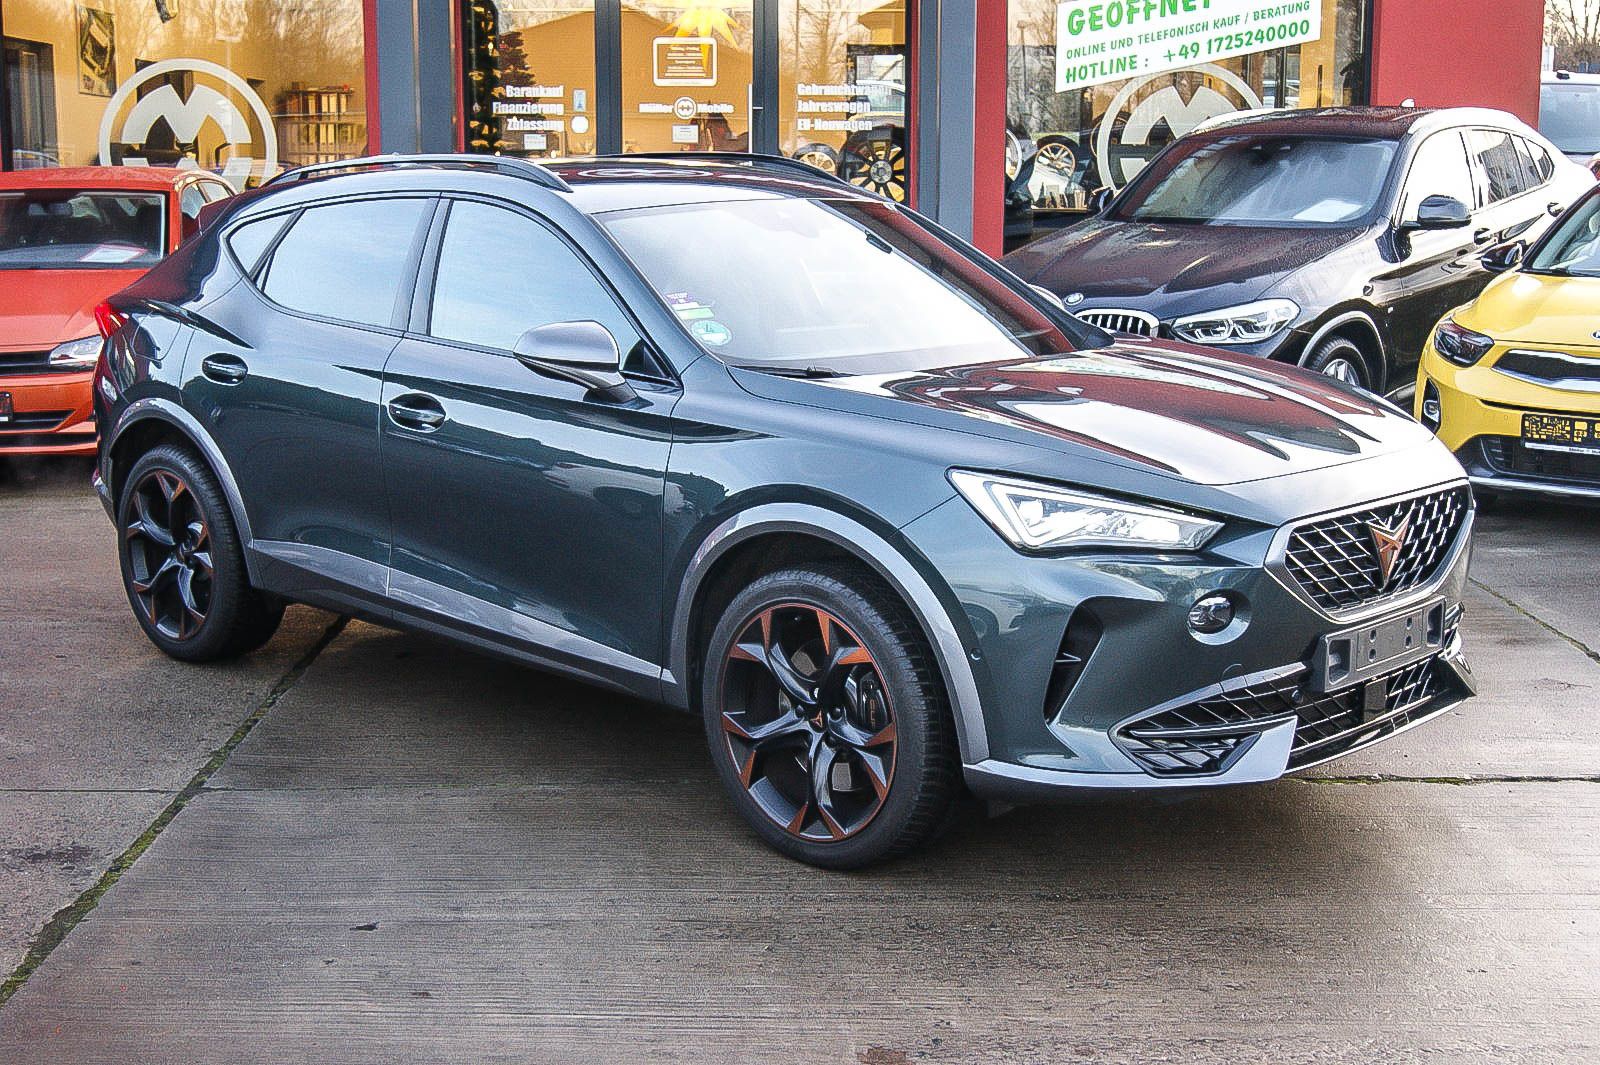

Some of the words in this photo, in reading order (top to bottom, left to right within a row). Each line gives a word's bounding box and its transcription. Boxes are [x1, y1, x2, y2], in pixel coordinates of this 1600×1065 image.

[1066, 42, 1106, 59] ONLINE
[1110, 37, 1133, 50] UND
[1138, 21, 1209, 45] TELEFONISCH
[1213, 15, 1241, 30] KAUF
[1253, 1, 1310, 21] BERATUNG
[1066, 55, 1138, 83] HOTLINE
[1163, 43, 1199, 62] +49
[1207, 20, 1310, 54] 1725240000
[797, 83, 891, 96] Gebrauchtwa
[492, 102, 564, 115] Finanzierung
[797, 99, 871, 113] Jahreswagen
